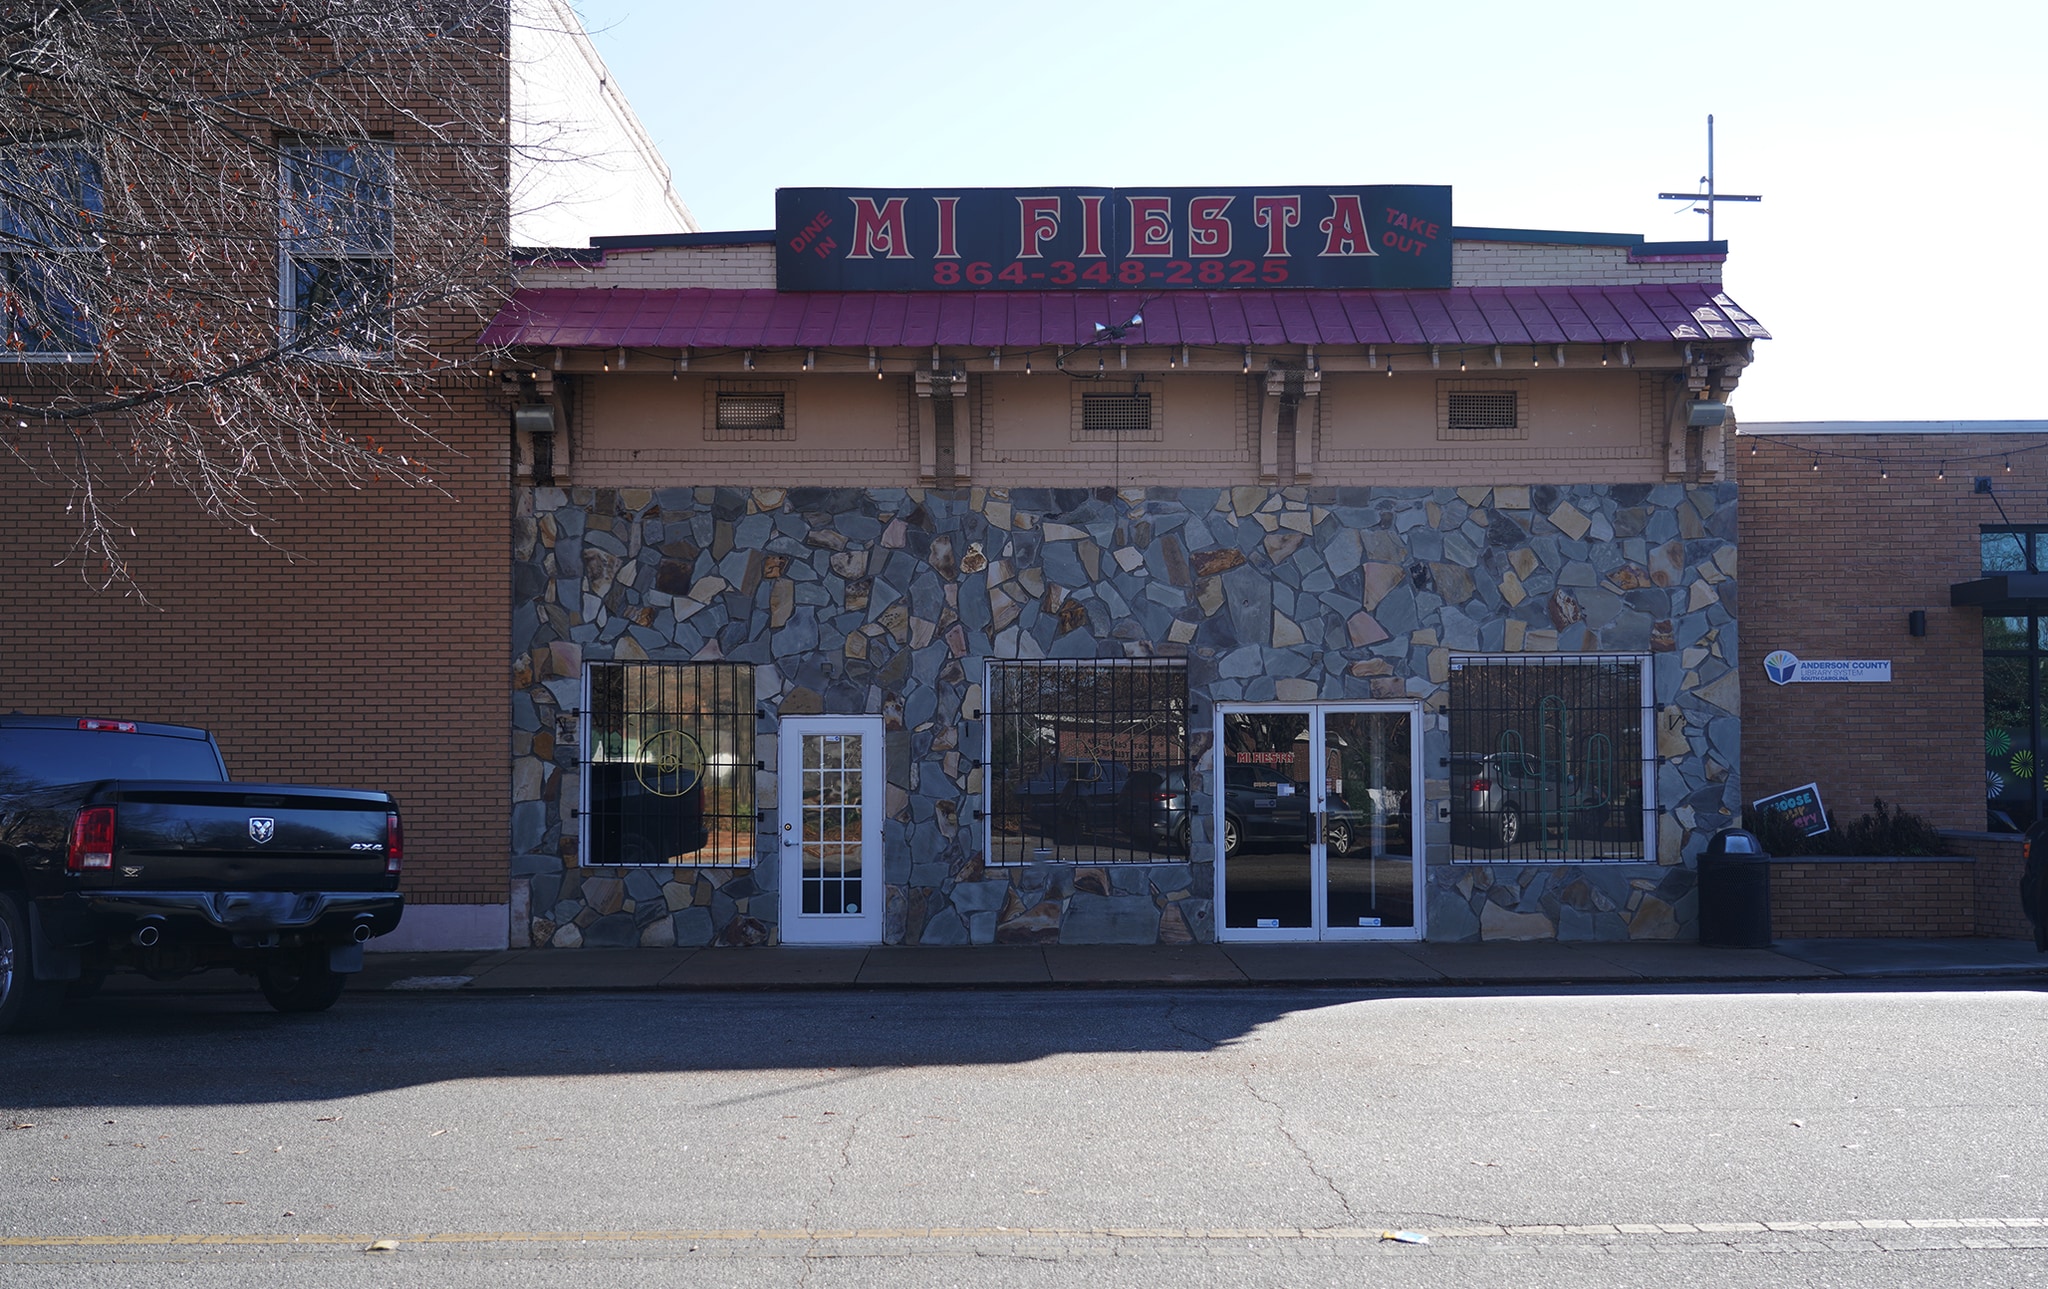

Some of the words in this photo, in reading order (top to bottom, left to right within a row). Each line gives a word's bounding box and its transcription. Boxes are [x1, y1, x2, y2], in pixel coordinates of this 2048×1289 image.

[789, 210, 833, 254] DINE
[845, 196, 962, 259] MI
[1015, 194, 1380, 259] FIESTA
[1385, 207, 1440, 240] TAKE
[814, 235, 838, 260] IN
[1381, 230, 1427, 257] OUT
[932, 259, 1290, 285] 864-348-2825
[1800, 661, 1849, 669] ANDERSON
[1852, 661, 1889, 669] COUNTY
[1237, 752, 1251, 763] MI
[1252, 751, 1294, 763] FIESTA
